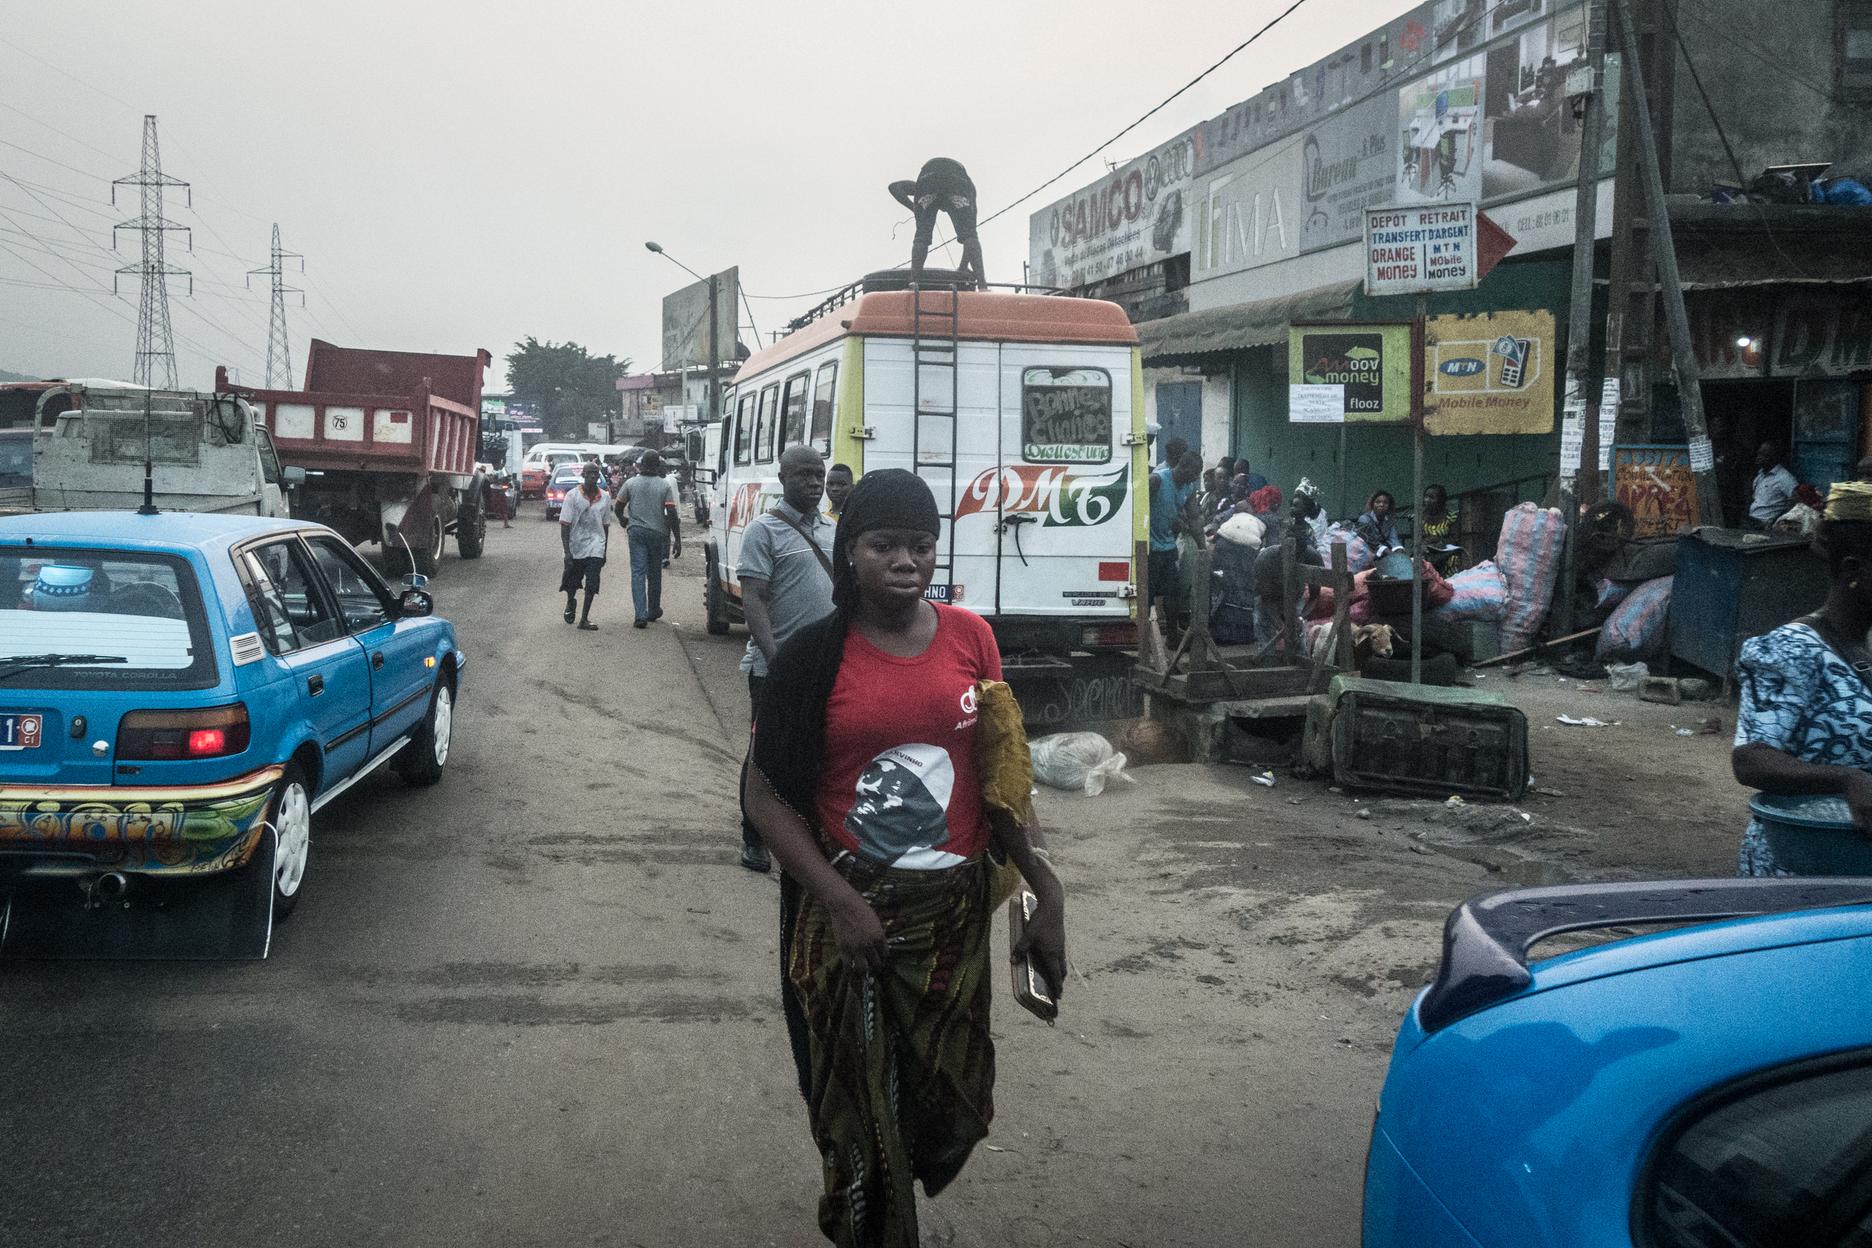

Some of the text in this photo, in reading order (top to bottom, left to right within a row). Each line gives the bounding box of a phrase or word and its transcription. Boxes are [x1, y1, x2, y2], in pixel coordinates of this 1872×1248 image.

[1060, 168, 1143, 249] SAMCO
[1420, 210, 1467, 225] RETRAIT
[1372, 226, 1469, 244] TRANSFERT D'ARGENT
[1372, 246, 1415, 263] ORANGE
[1447, 361, 1478, 373] MTN
[1326, 371, 1380, 386] money
[1350, 398, 1380, 409] flooz
[1440, 396, 1530, 410] Mobile Money
[334, 418, 346, 428] 75
[73, 671, 178, 680] TOYOTA COROLLA
[5, 718, 13, 743] 1
